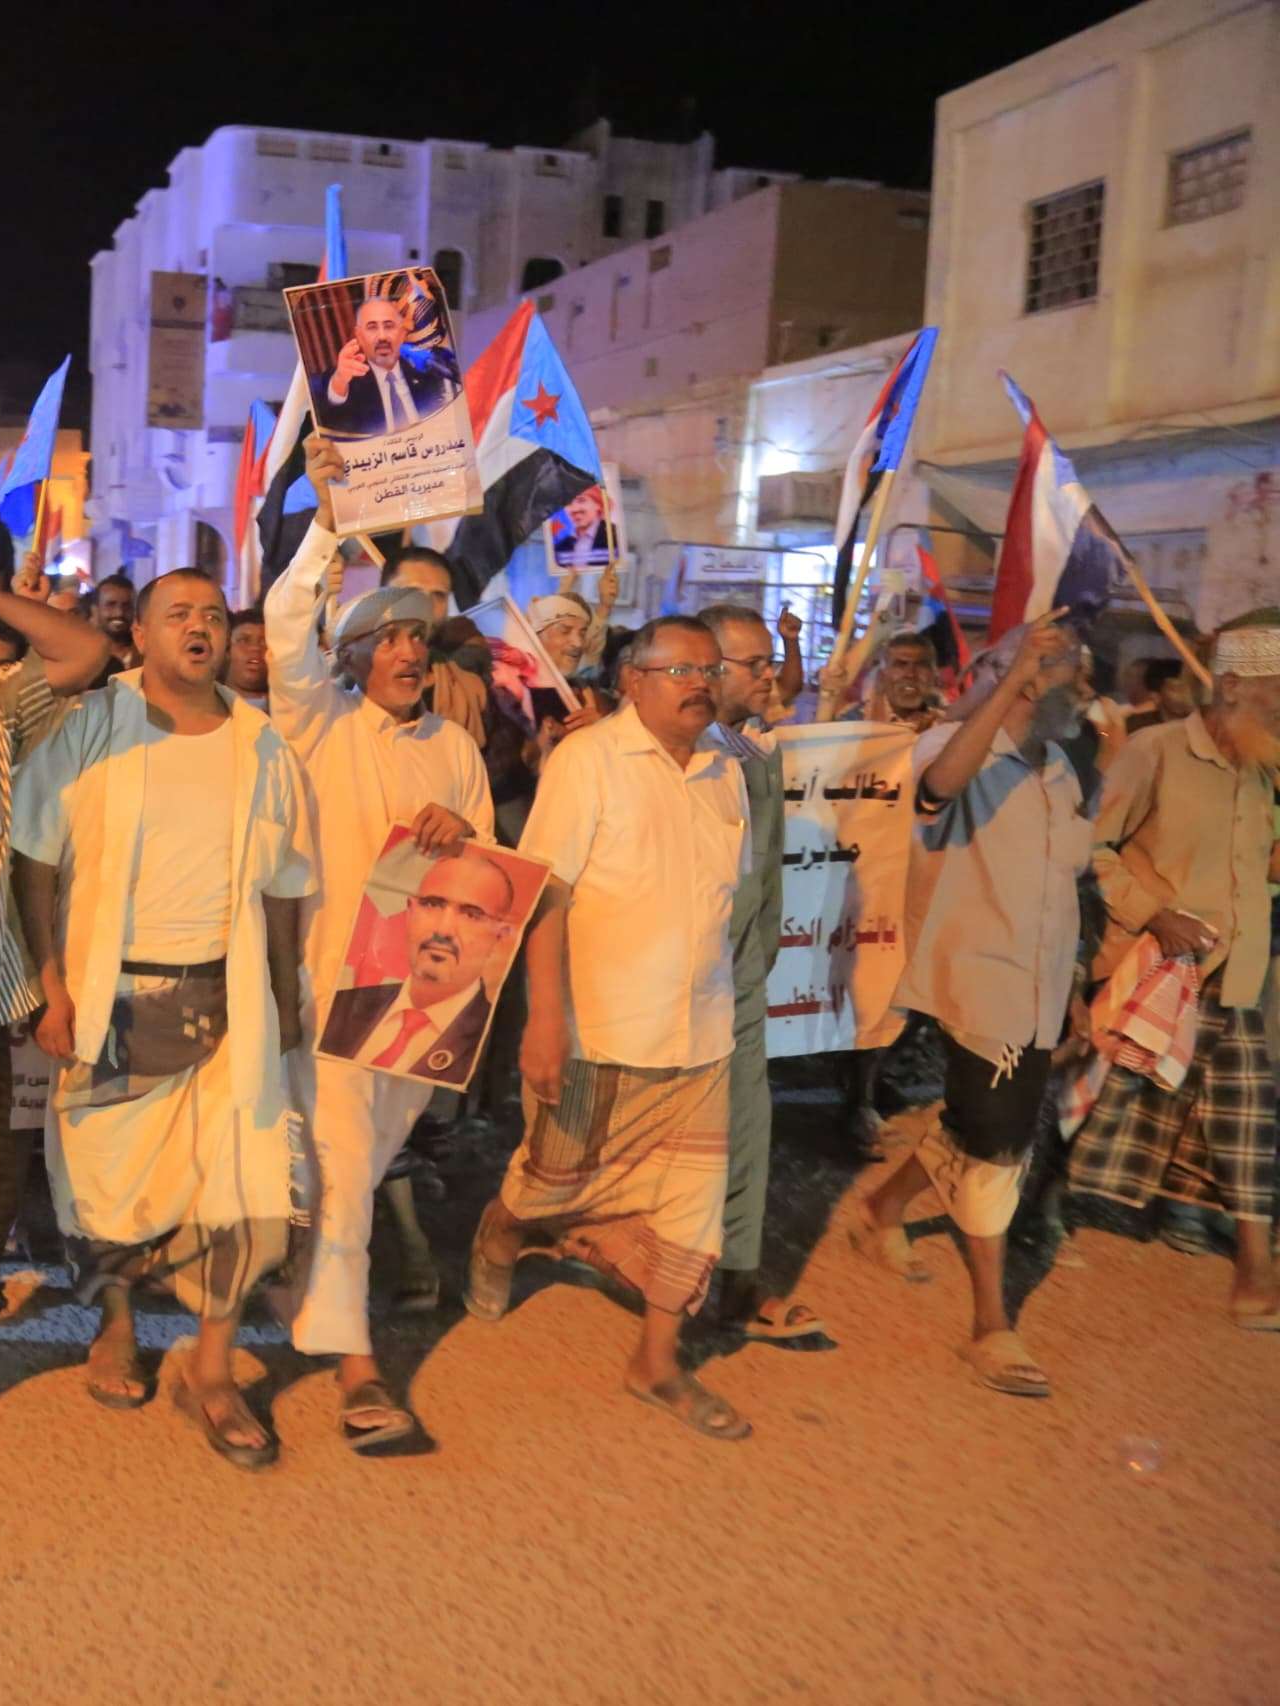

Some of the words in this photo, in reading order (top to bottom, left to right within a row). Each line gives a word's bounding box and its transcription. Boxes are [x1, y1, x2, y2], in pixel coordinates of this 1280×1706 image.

[390, 442, 418, 466] قاسم
[420, 438, 466, 460] عيدروس
[374, 485, 408, 504] القطن
[411, 480, 445, 495] مديرية
